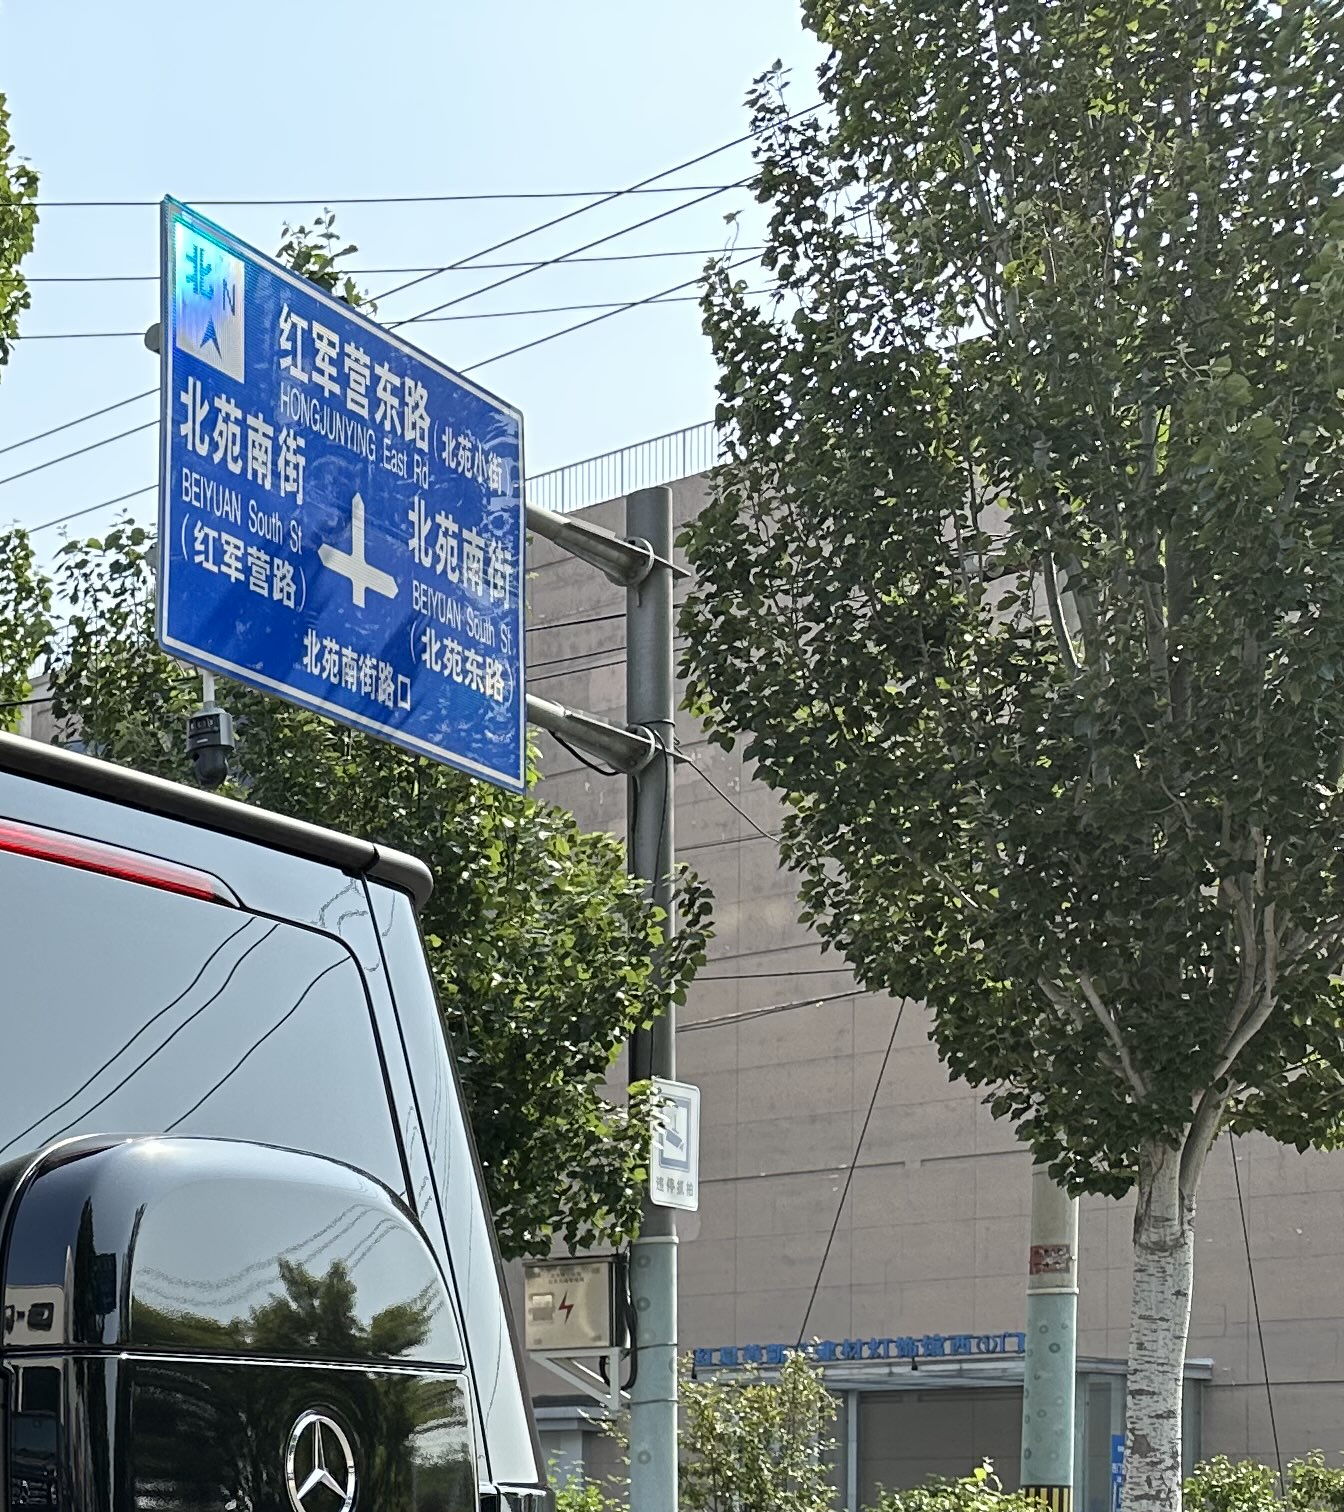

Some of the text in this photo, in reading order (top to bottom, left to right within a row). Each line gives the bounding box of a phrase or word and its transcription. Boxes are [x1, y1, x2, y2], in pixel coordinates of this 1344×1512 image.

[185, 244, 214, 300] 北
[222, 278, 235, 317] N
[279, 302, 431, 454] 红军营东路
[179, 375, 305, 505] 北苑南街
[279, 382, 429, 490] HONGJUNYING East Rd
[181, 466, 303, 554] BEIYUAN South St
[408, 495, 512, 608] 北苑南街
[412, 579, 512, 655] BEIYUAN South St
[302, 628, 412, 712] 北苑南街路口
